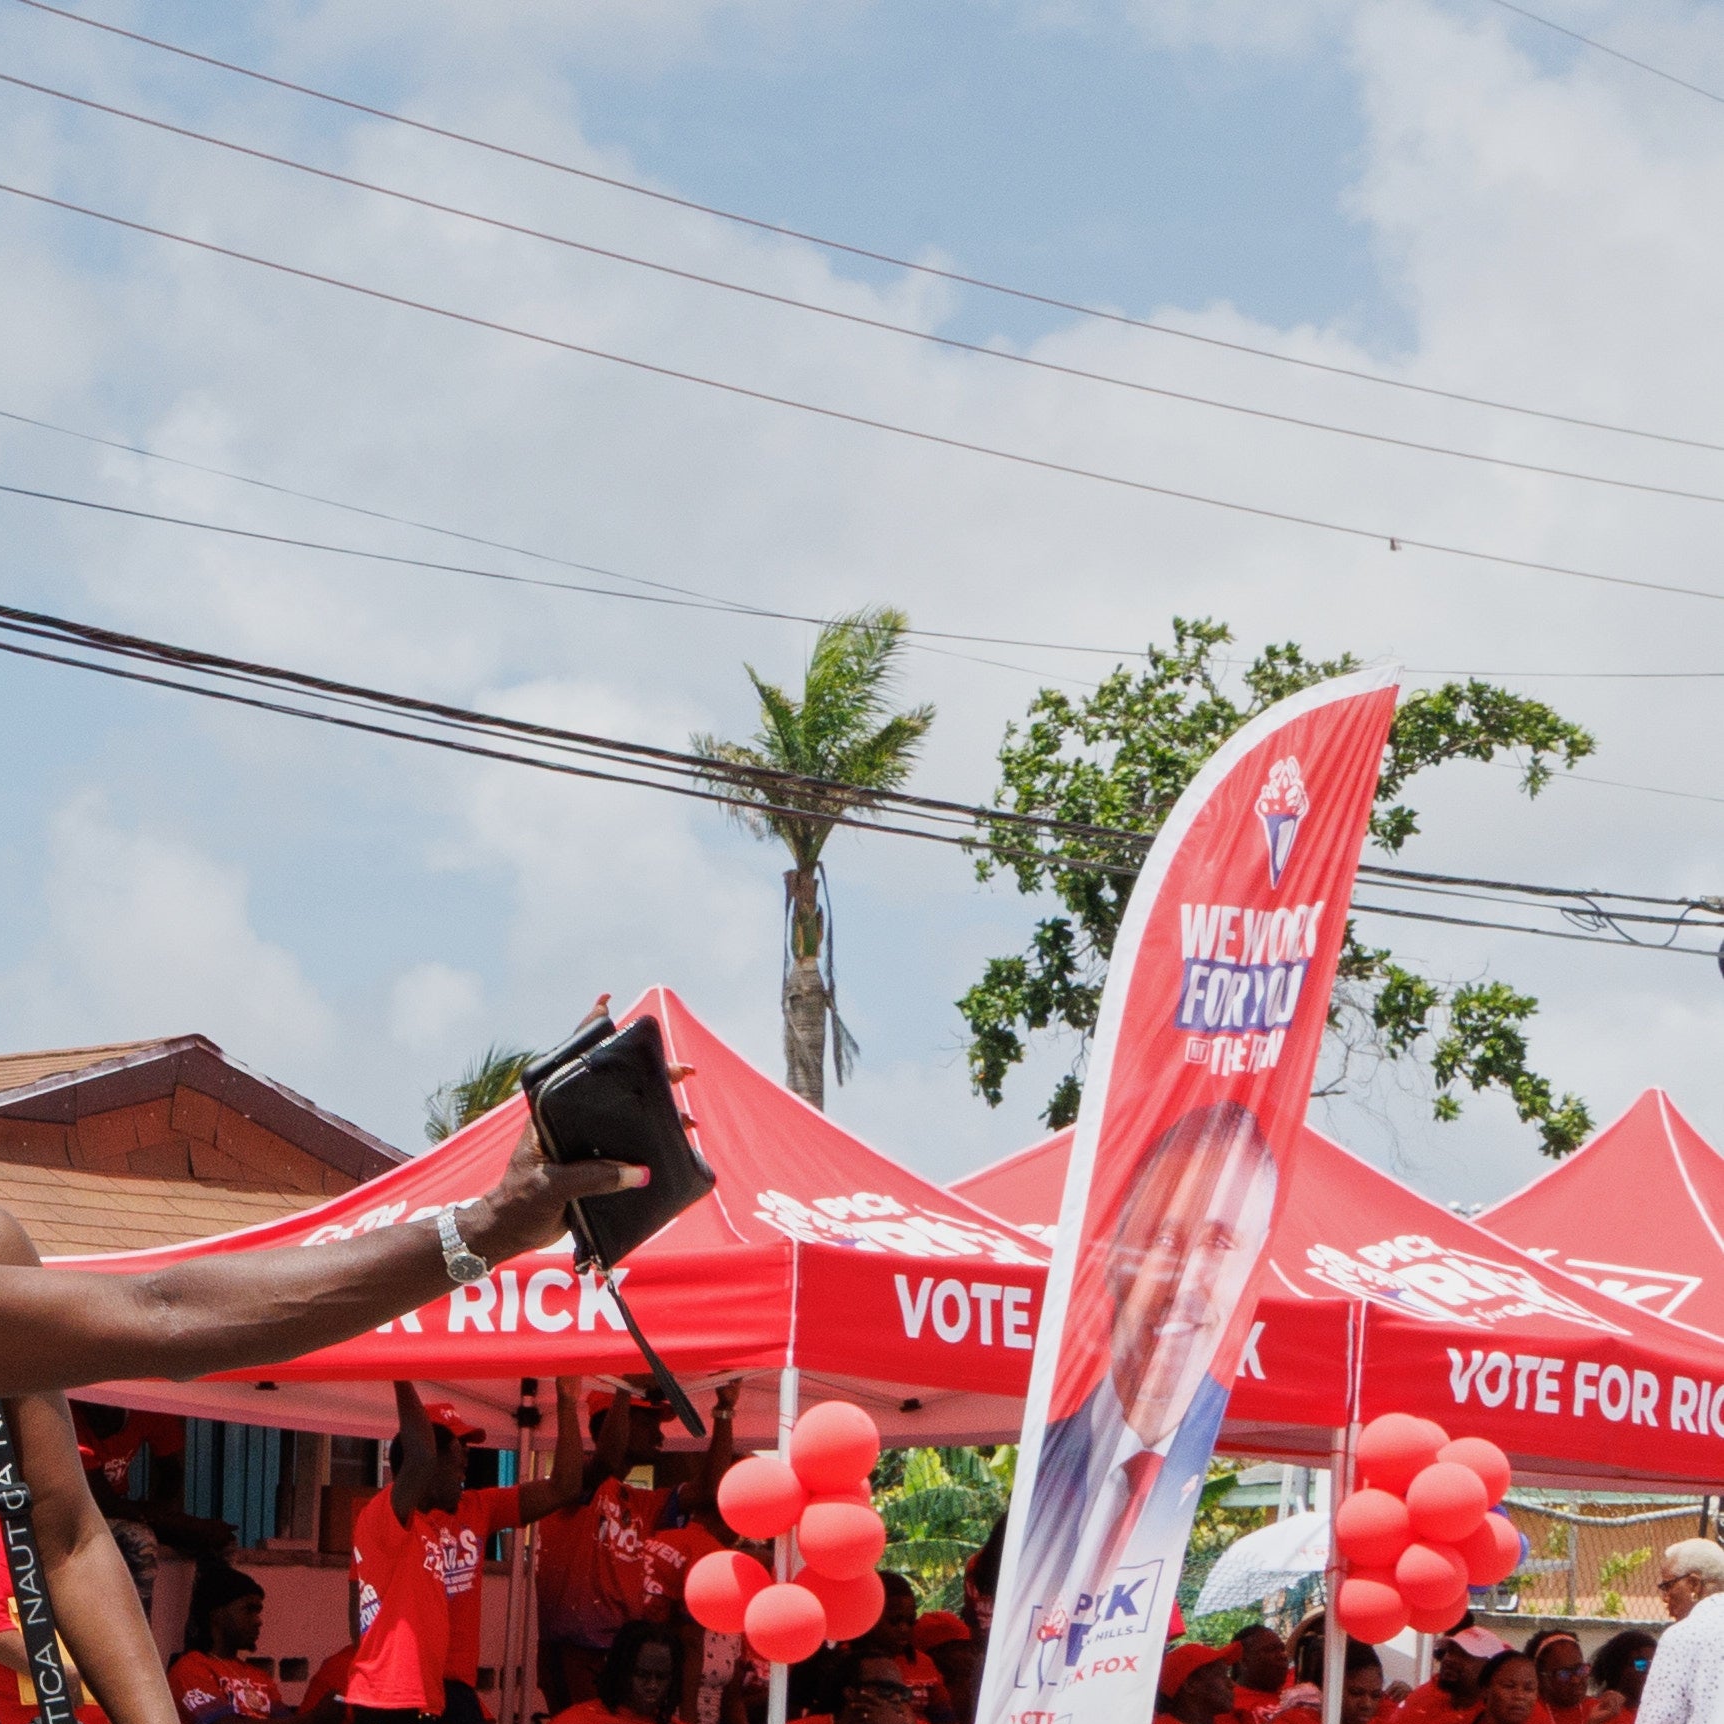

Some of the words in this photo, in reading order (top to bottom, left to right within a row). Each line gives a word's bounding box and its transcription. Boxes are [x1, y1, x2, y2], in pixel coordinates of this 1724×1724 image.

[1180, 903, 1242, 963] WE
[1239, 900, 1325, 966] WORK
[1181, 964, 1250, 1027] FOR
[448, 1267, 630, 1333] RICK
[894, 1273, 1033, 1350] VOTE
[1447, 1348, 1565, 1414] VOTE
[1572, 1361, 1659, 1429] FOR
[1670, 1374, 1724, 1442] RIC
[1091, 1655, 1139, 1678] FOX
